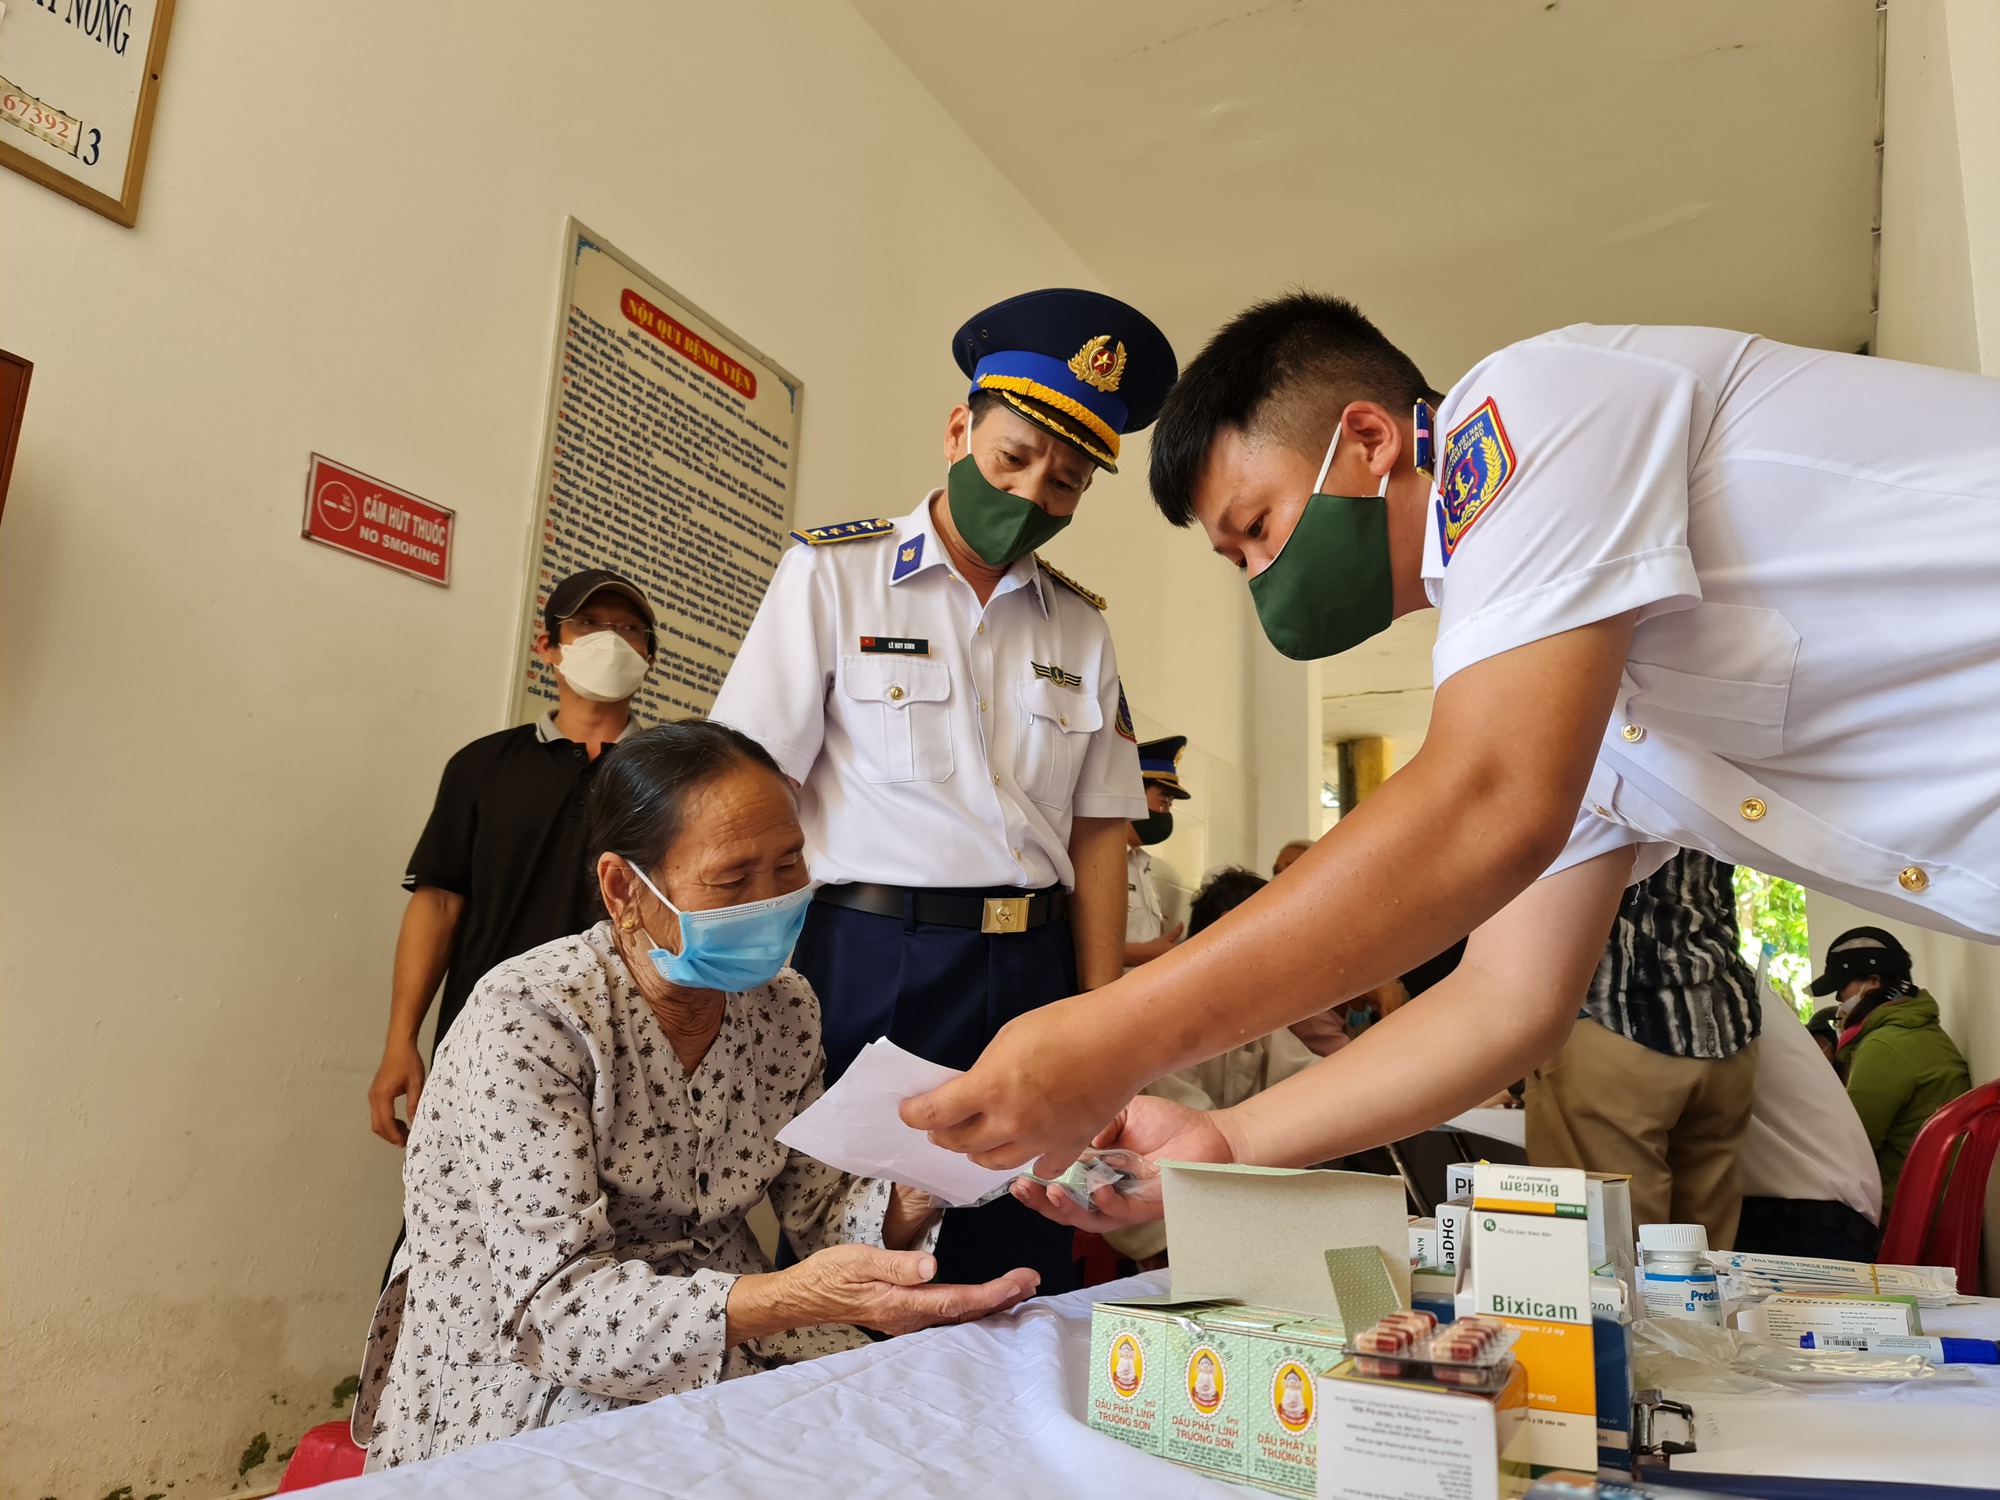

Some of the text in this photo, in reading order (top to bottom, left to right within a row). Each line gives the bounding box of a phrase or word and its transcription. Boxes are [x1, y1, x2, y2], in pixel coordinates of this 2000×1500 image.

[4, 94, 69, 139] 67392
[628, 299, 751, 391] NỘI QUI BỆNH VIỆN
[1469, 421, 1484, 434] NAM
[1463, 428, 1484, 450] GUARD
[363, 493, 446, 547] CẤM HÚT THUỐC
[359, 526, 440, 565] NO SMOKING
[1500, 1181, 1559, 1197] Bixicam
[1768, 1259, 1796, 1267] WOODEN
[1822, 1264, 1856, 1273] DEPRESSOR
[1493, 1295, 1578, 1320] Bixicam
[1136, 1409, 1155, 1420] LINH
[1218, 1426, 1239, 1438] LINH
[1307, 1444, 1317, 1454] LI
